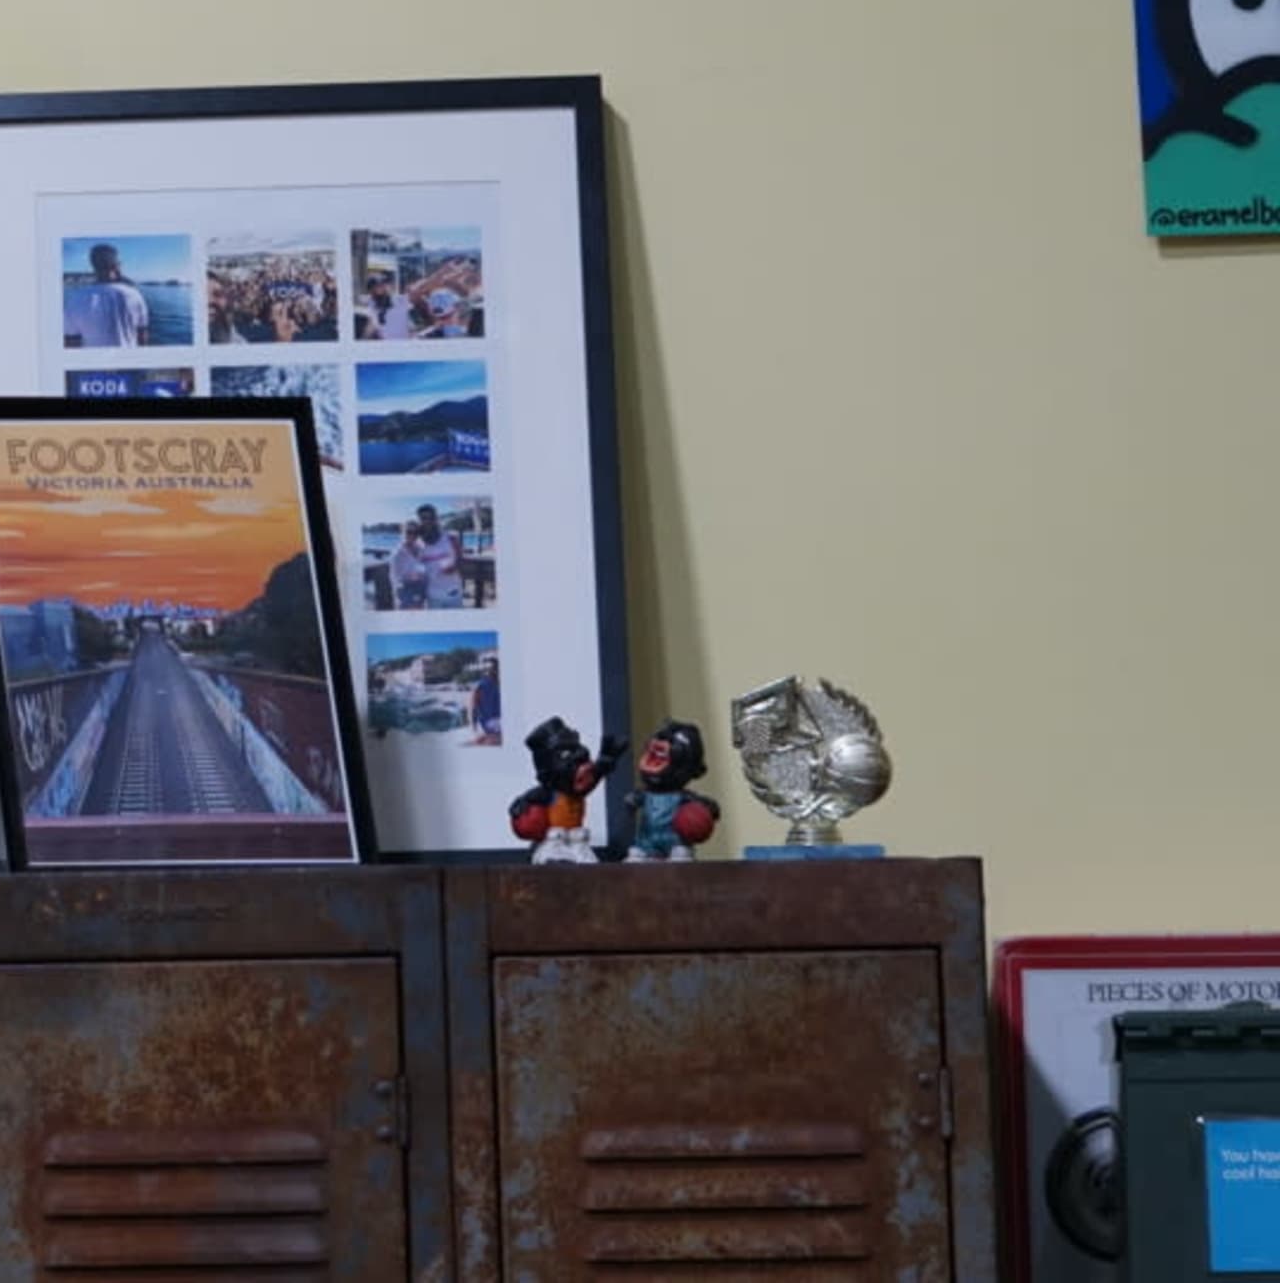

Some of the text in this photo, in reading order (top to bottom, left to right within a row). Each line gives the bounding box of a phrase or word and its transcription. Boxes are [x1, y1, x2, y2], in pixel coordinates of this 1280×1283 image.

[79, 379, 127, 394] KODA
[6, 437, 268, 475] FOOTSCRAY
[26, 475, 254, 491] VICTORIA AUSTRALIA
[1088, 982, 1164, 1002] PIECES
[1167, 982, 1200, 1002] OF
